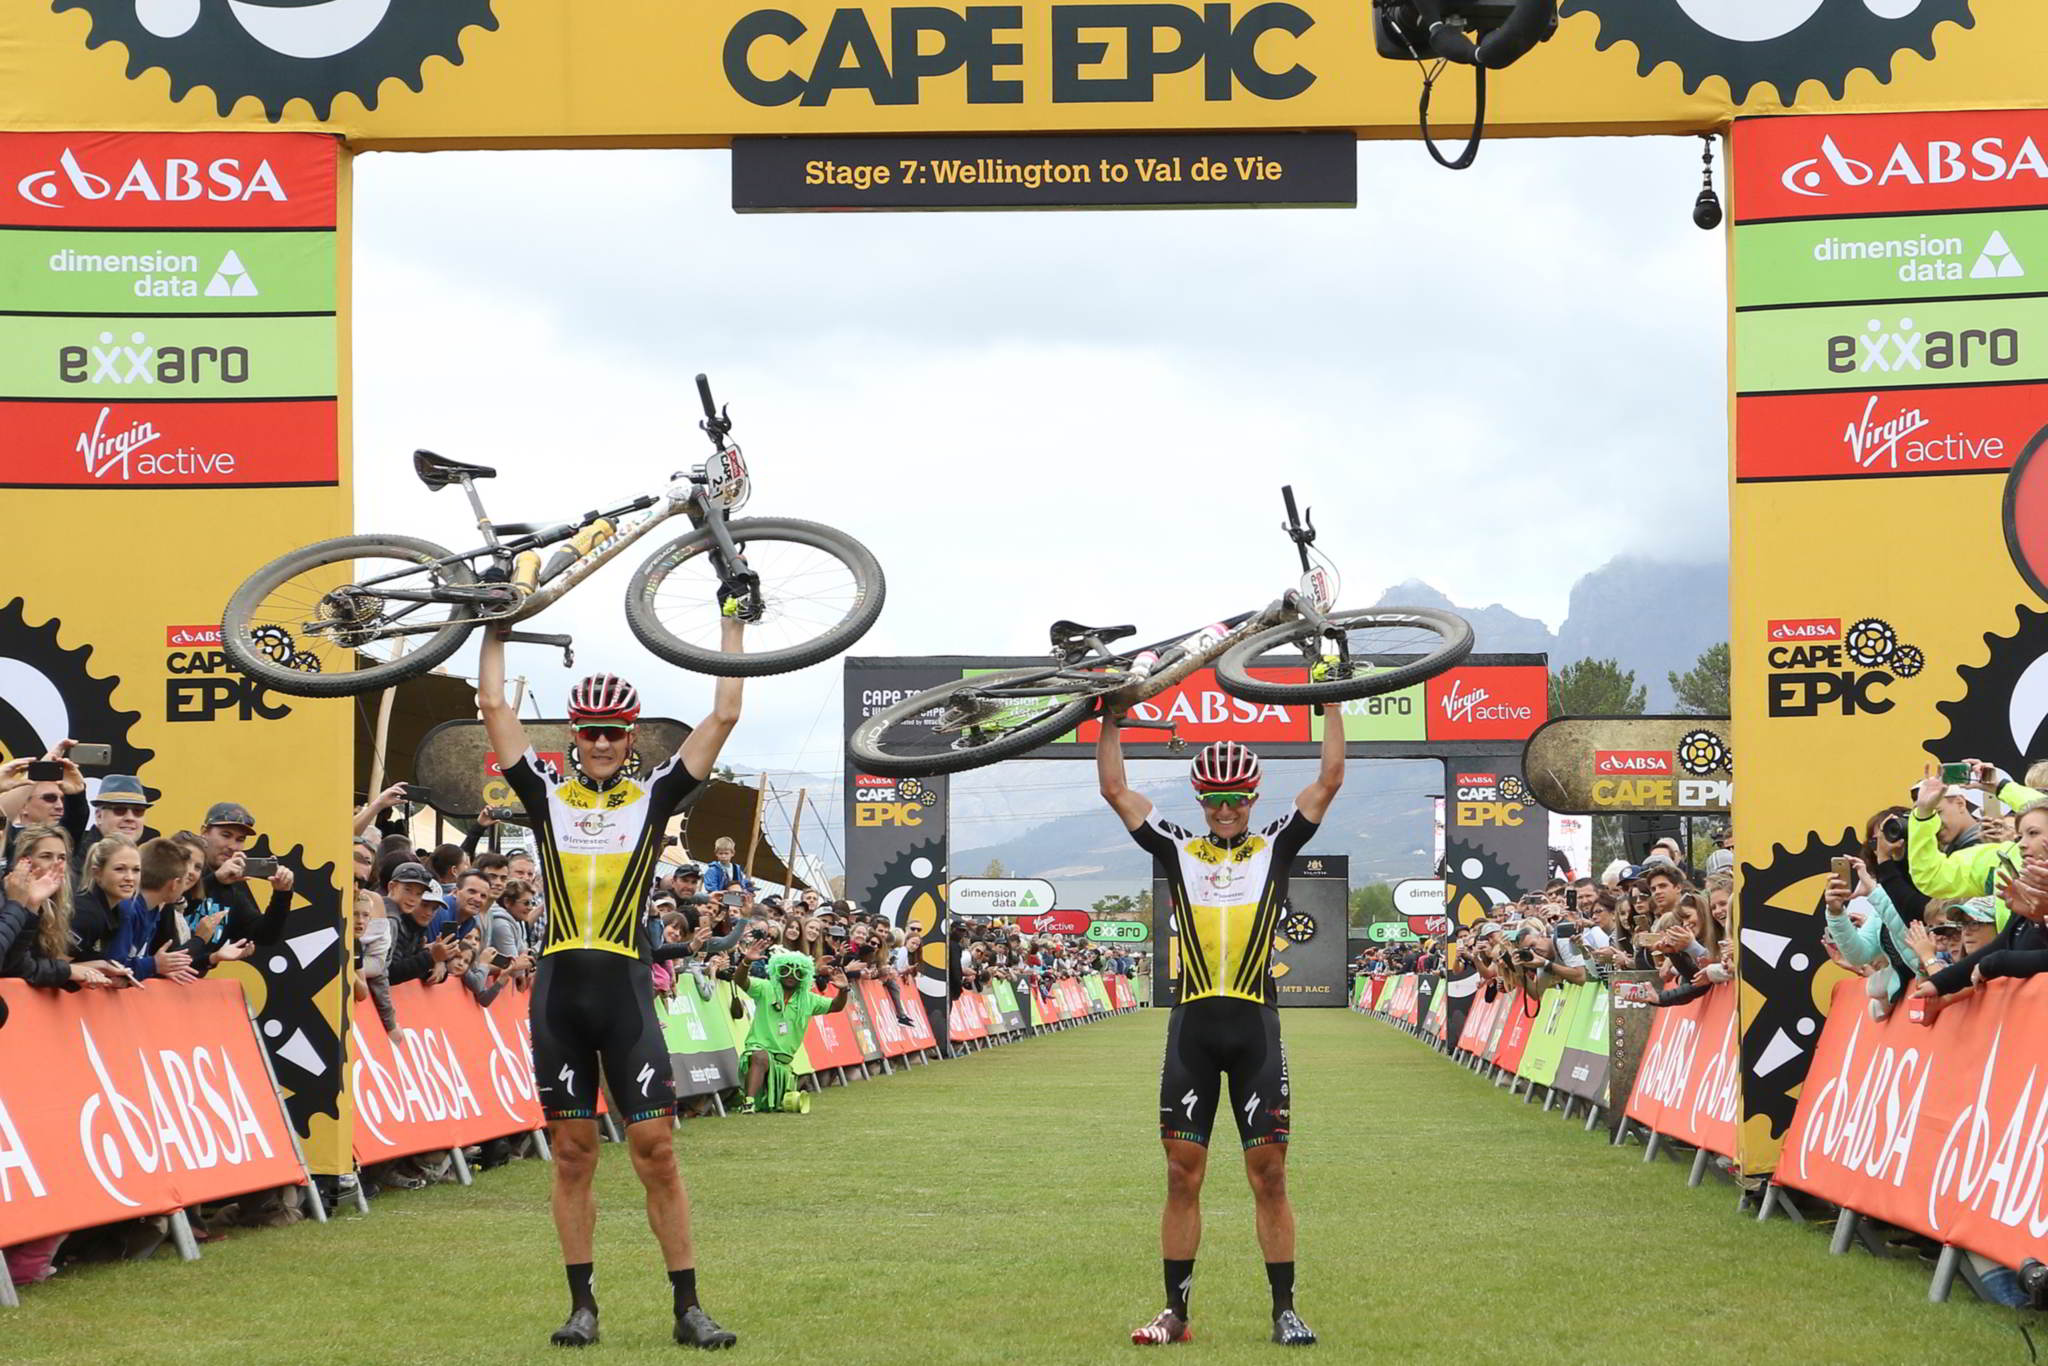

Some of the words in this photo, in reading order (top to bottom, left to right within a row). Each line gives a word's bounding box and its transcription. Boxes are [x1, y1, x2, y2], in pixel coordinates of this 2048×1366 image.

[723, 7, 1023, 107] CAPE
[1051, 2, 1317, 103] EPIC
[805, 159, 890, 190] Stage
[900, 161, 926, 184] 7:
[931, 158, 1090, 189] Wellington
[1100, 159, 1128, 183] to
[1136, 157, 1181, 182] Val
[1191, 157, 1228, 181] de
[1234, 155, 1282, 181] Vie
[1878, 135, 2048, 186] ABSA
[115, 158, 289, 201] ABSA
[1814, 233, 1962, 261] dimension
[49, 249, 198, 272] dimension
[1899, 259, 1962, 282] data
[134, 275, 198, 297] data
[60, 331, 249, 384] exxaro
[1828, 318, 2018, 373] exxaro
[76, 407, 160, 480] Virgin
[137, 447, 235, 475] active
[1844, 395, 1929, 468] Virgin
[1905, 432, 2004, 463] active
[193, 631, 222, 642] ABS
[1795, 625, 1836, 637] ABSA
[1768, 645, 1841, 669] CAPE
[166, 678, 292, 722] EPIC
[1342, 696, 1411, 715] xxaro
[1441, 680, 1489, 722] Virgin
[1476, 703, 1531, 719] active
[1768, 670, 1896, 717] EPIC
[1623, 757, 1667, 770] ABSA
[856, 788, 896, 801] CAPE
[1457, 787, 1497, 801] CAPE
[1591, 780, 1673, 806] CAPE
[1678, 779, 1733, 807] EPI
[856, 802, 922, 826] EPIC
[1456, 801, 1524, 826] EPIC
[961, 889, 1017, 898] dimension
[992, 899, 1017, 907] data
[1409, 888, 1444, 898] dimen
[1033, 916, 1055, 932] Virgin
[1048, 922, 1075, 931] active
[1093, 923, 1140, 937] exxaro
[388, 1028, 482, 1123] ABSA
[1650, 1018, 1703, 1110] ABSA
[139, 1046, 273, 1172] ABSA
[1831, 1045, 1934, 1187] ABSA
